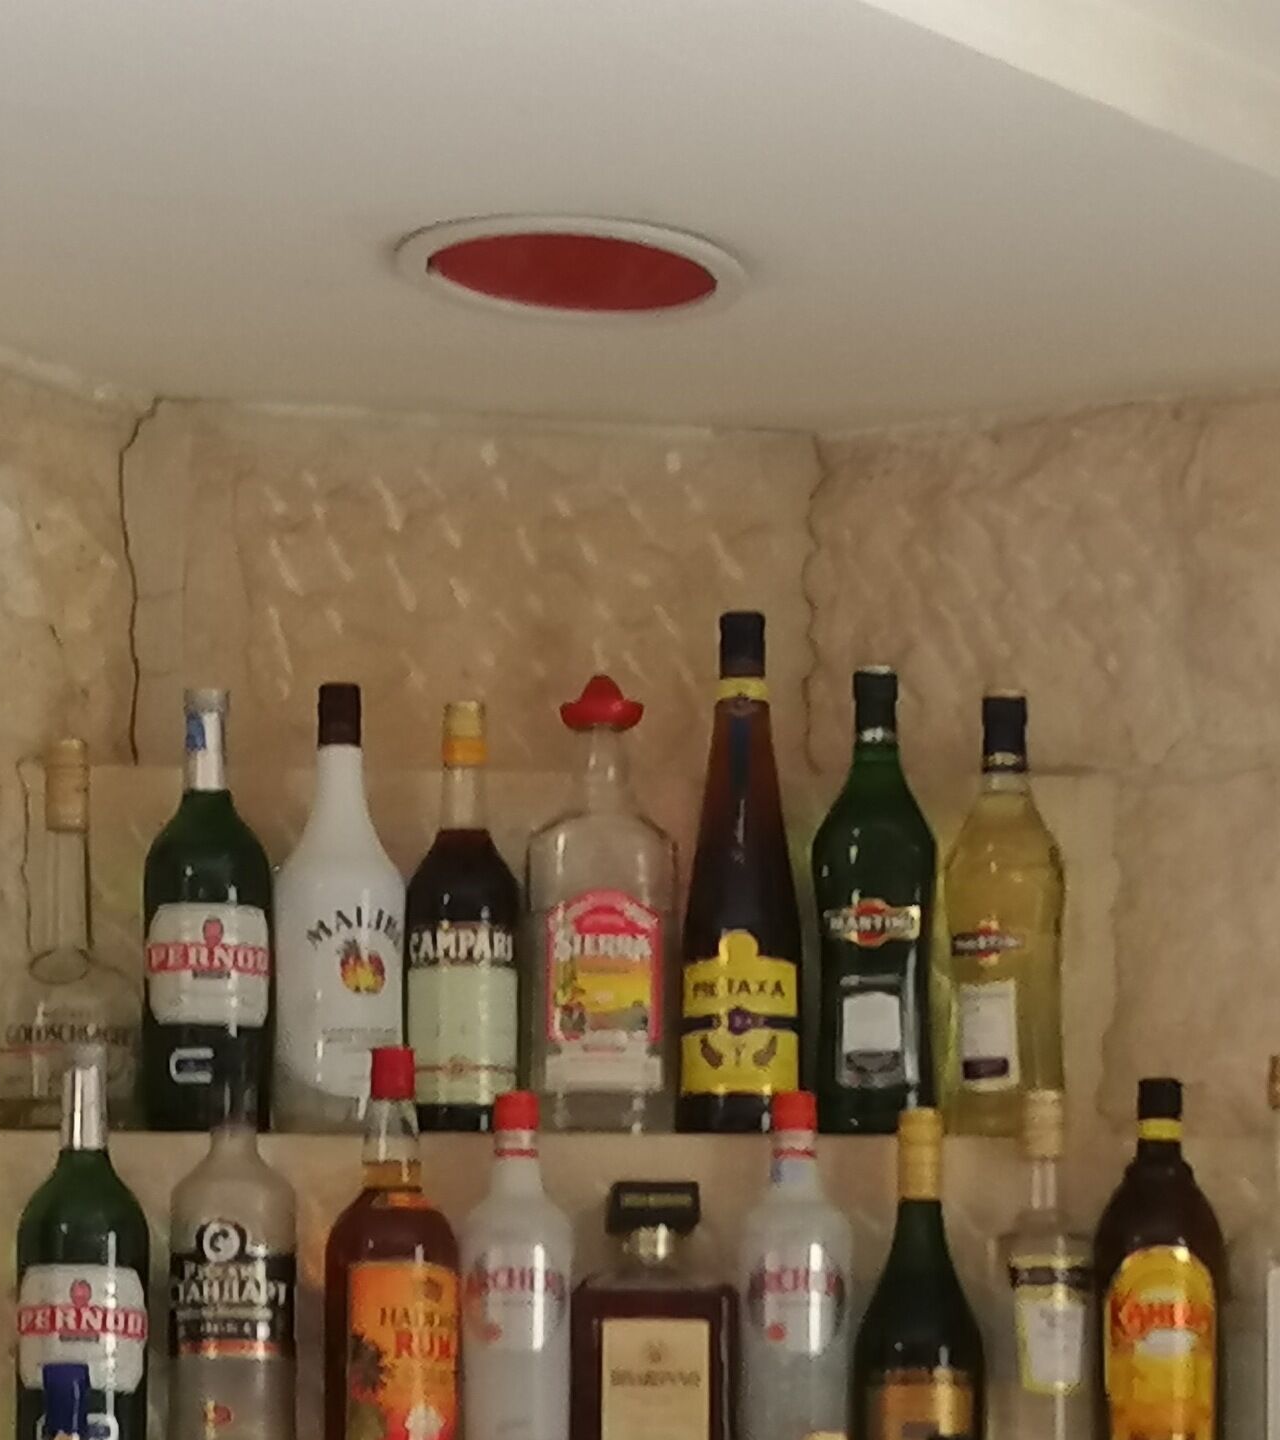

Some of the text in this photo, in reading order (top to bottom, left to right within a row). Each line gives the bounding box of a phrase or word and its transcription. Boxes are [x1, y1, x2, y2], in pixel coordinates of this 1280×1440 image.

[305, 905, 405, 950] MALIB
[409, 927, 514, 963] CAMPARI
[20, 1305, 145, 1338] PERNOD
